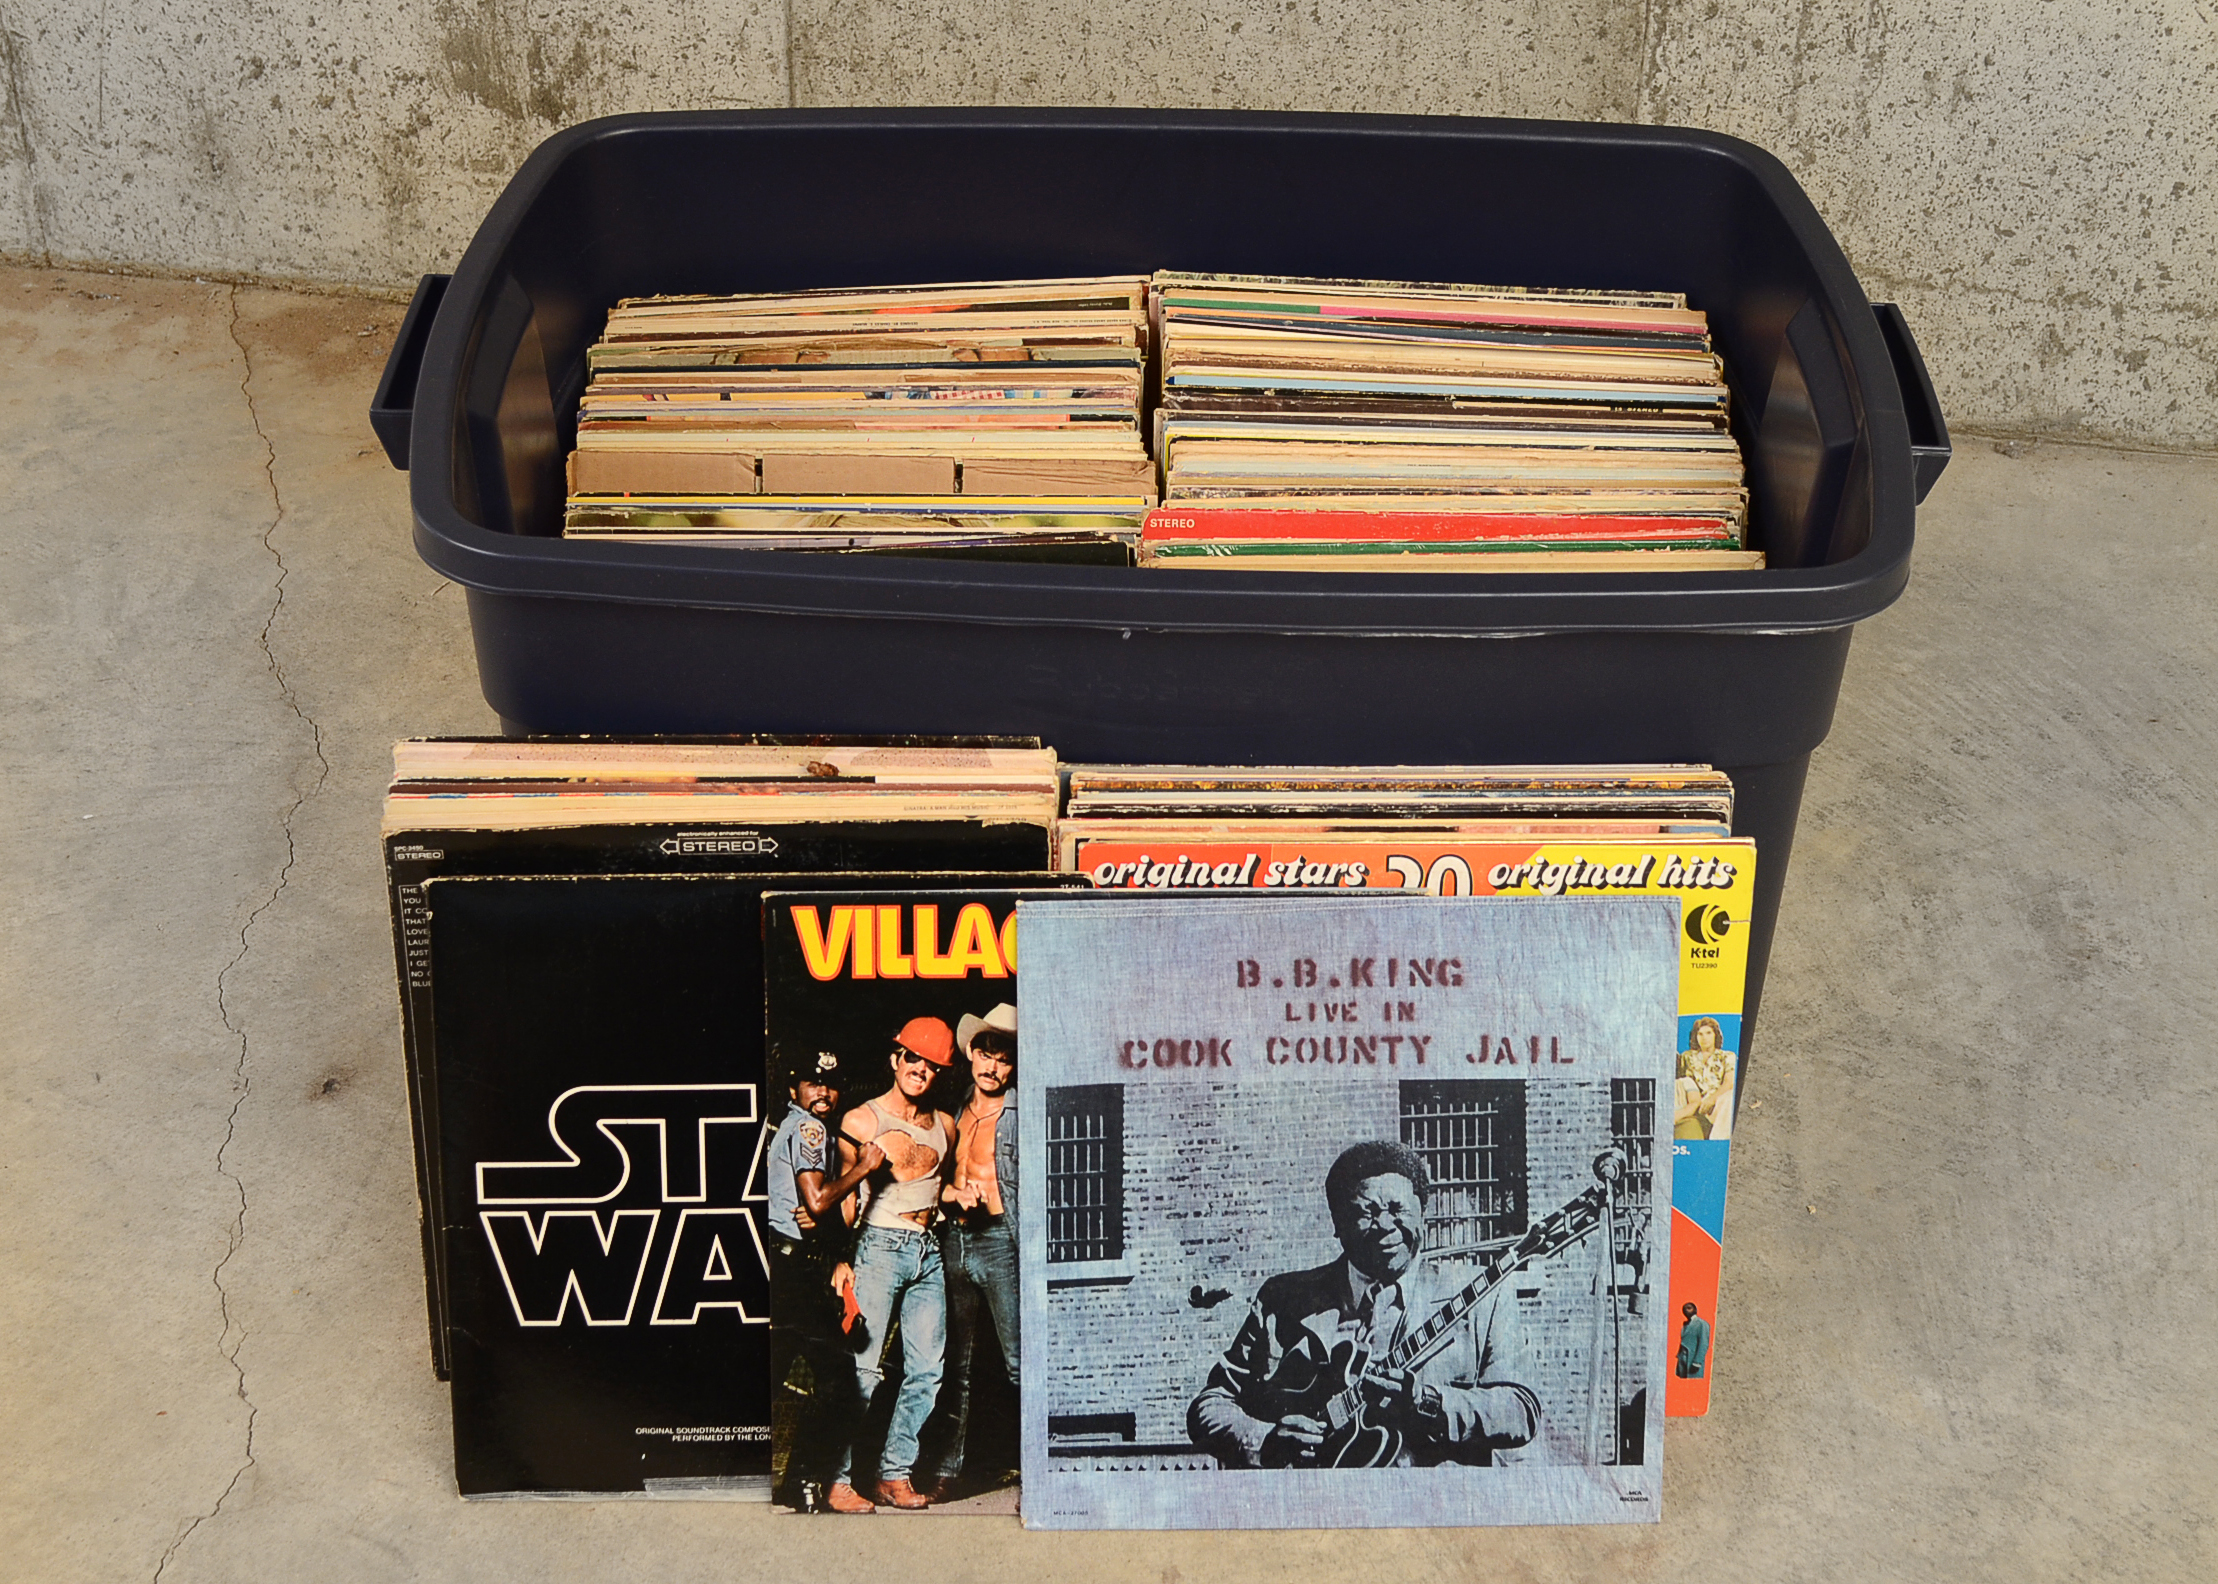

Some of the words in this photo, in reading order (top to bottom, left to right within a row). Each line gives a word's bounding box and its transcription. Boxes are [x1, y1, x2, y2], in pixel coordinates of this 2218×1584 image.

[1150, 518, 1195, 528] STEREO
[682, 841, 756, 852] STEREO
[1094, 853, 1261, 889] original
[1265, 856, 1371, 888] stars
[1488, 853, 1654, 896] original
[1657, 854, 1737, 890] hits
[1285, 1001, 1358, 1024] LIVE
[1383, 1001, 1417, 1023] IN
[1120, 1037, 1233, 1069] COOK
[1267, 1035, 1433, 1067] COUNTY
[1467, 1035, 1575, 1066] JAIL
